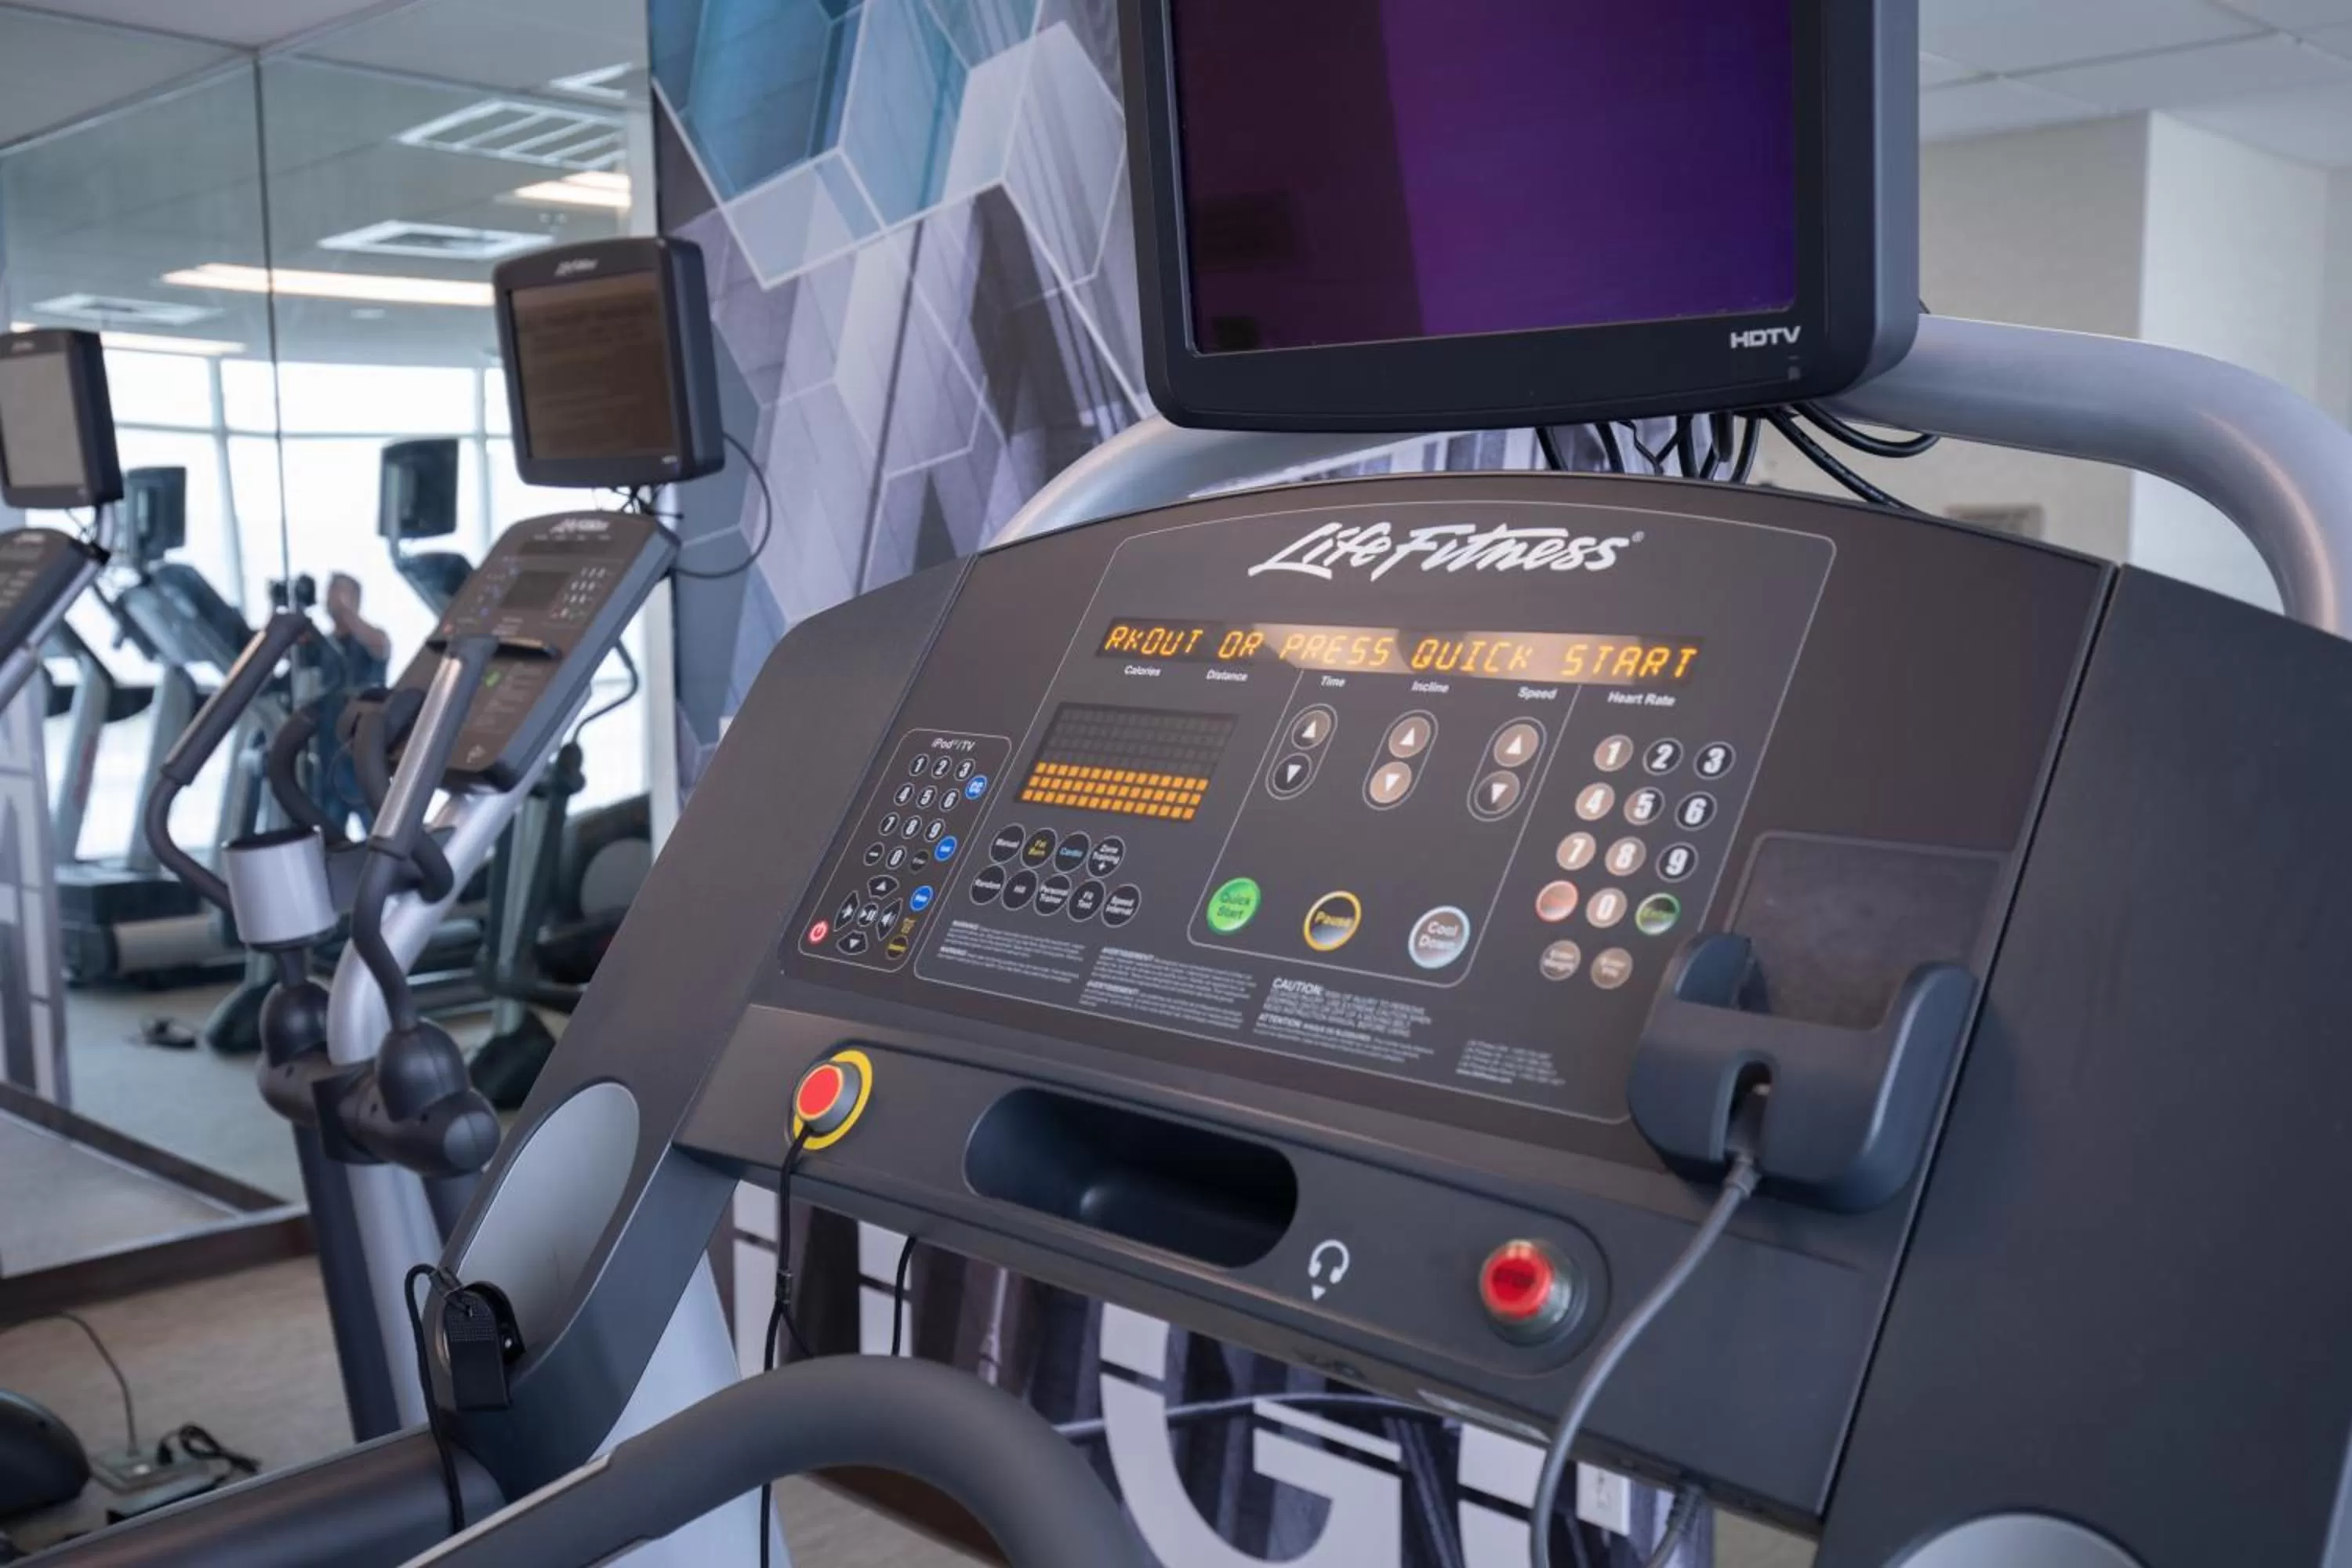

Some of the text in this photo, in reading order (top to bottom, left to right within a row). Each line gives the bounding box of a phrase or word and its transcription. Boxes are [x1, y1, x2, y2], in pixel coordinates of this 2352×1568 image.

[1730, 325, 1802, 349] HDTV
[1247, 522, 1392, 580] Life
[1105, 625, 1698, 679] RKOUT OR PRESS QUICK START
[1206, 669, 1248, 683] Distance
[1321, 674, 1346, 688] Time
[1411, 681, 1450, 694] Incline
[1518, 685, 1558, 702] Speed
[1607, 691, 1676, 707] Heart Rate
[914, 757, 971, 778] 1 2 3
[1606, 741, 1726, 774] 1 2 3
[898, 786, 956, 808] 4 5 6
[1585, 789, 1707, 825] 4 5 6
[906, 818, 918, 835] 8
[928, 822, 942, 839] 9
[1568, 838, 1689, 876] 7 8 9
[1596, 894, 1617, 920] 0
